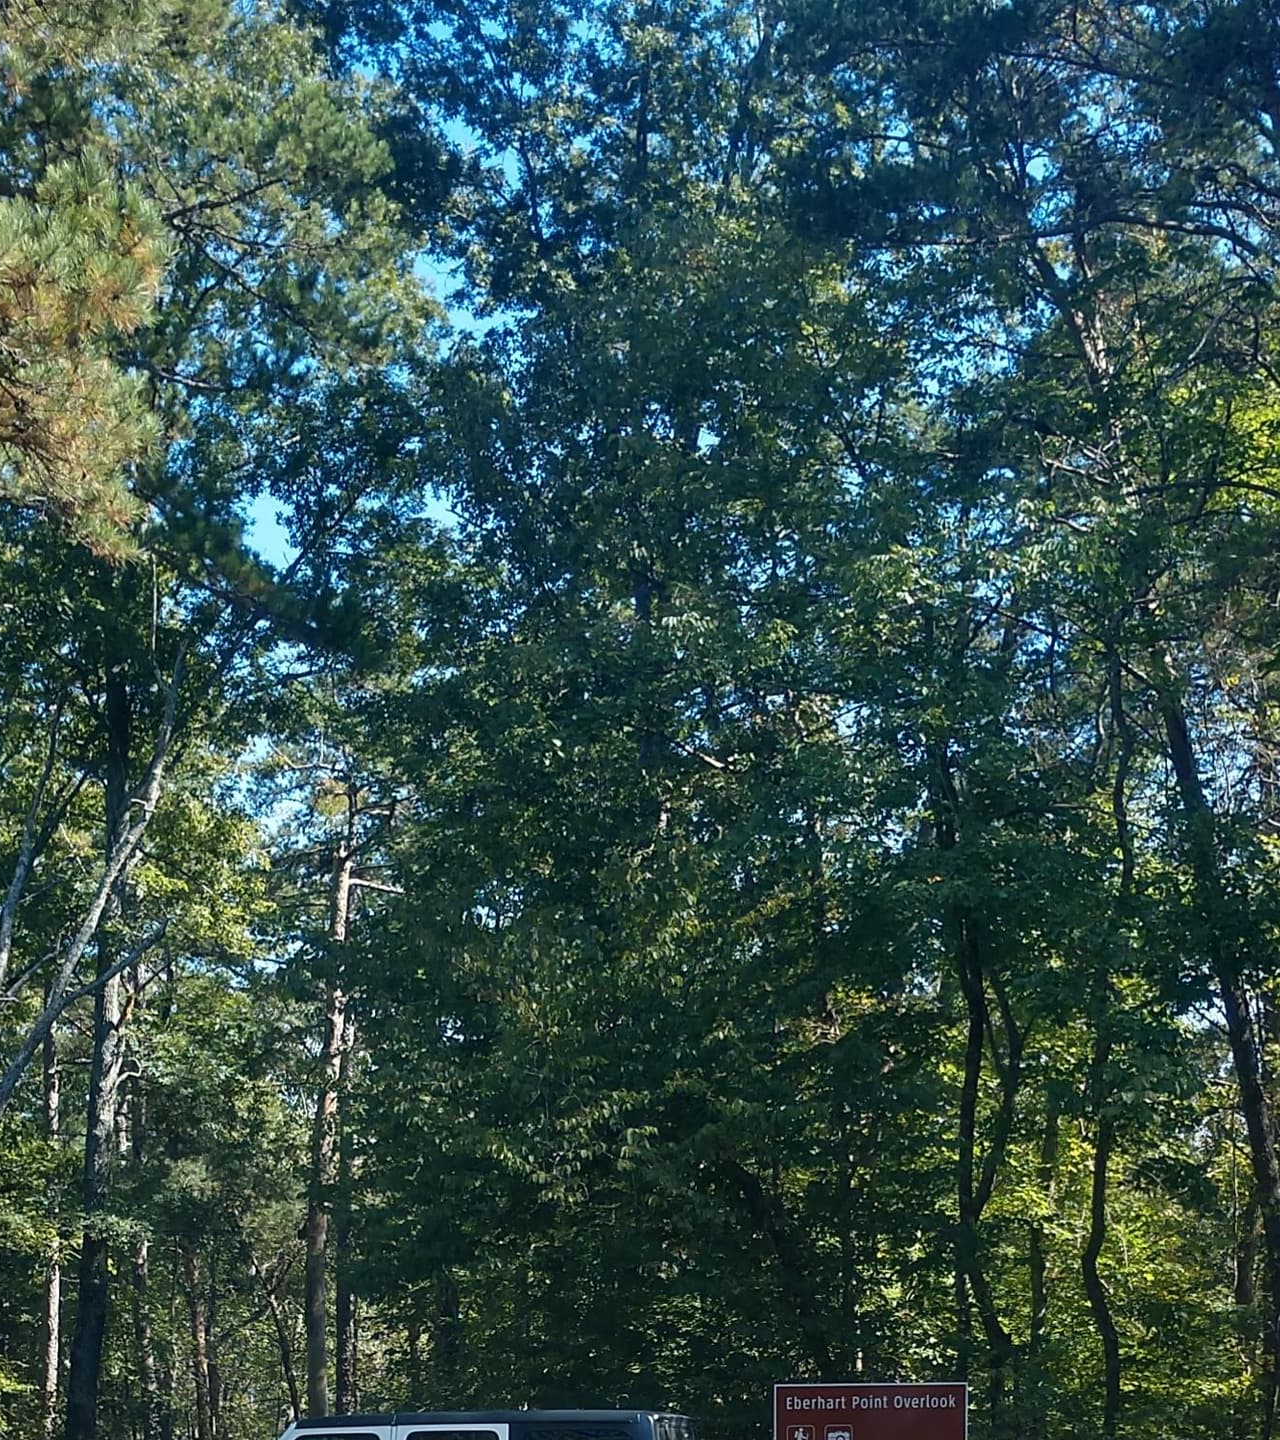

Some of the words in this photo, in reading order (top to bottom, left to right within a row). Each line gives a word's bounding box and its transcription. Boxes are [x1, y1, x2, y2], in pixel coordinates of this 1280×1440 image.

[786, 1395, 846, 1410] Eberhart
[852, 1394, 888, 1409] Point
[894, 1394, 956, 1409] Overlook
